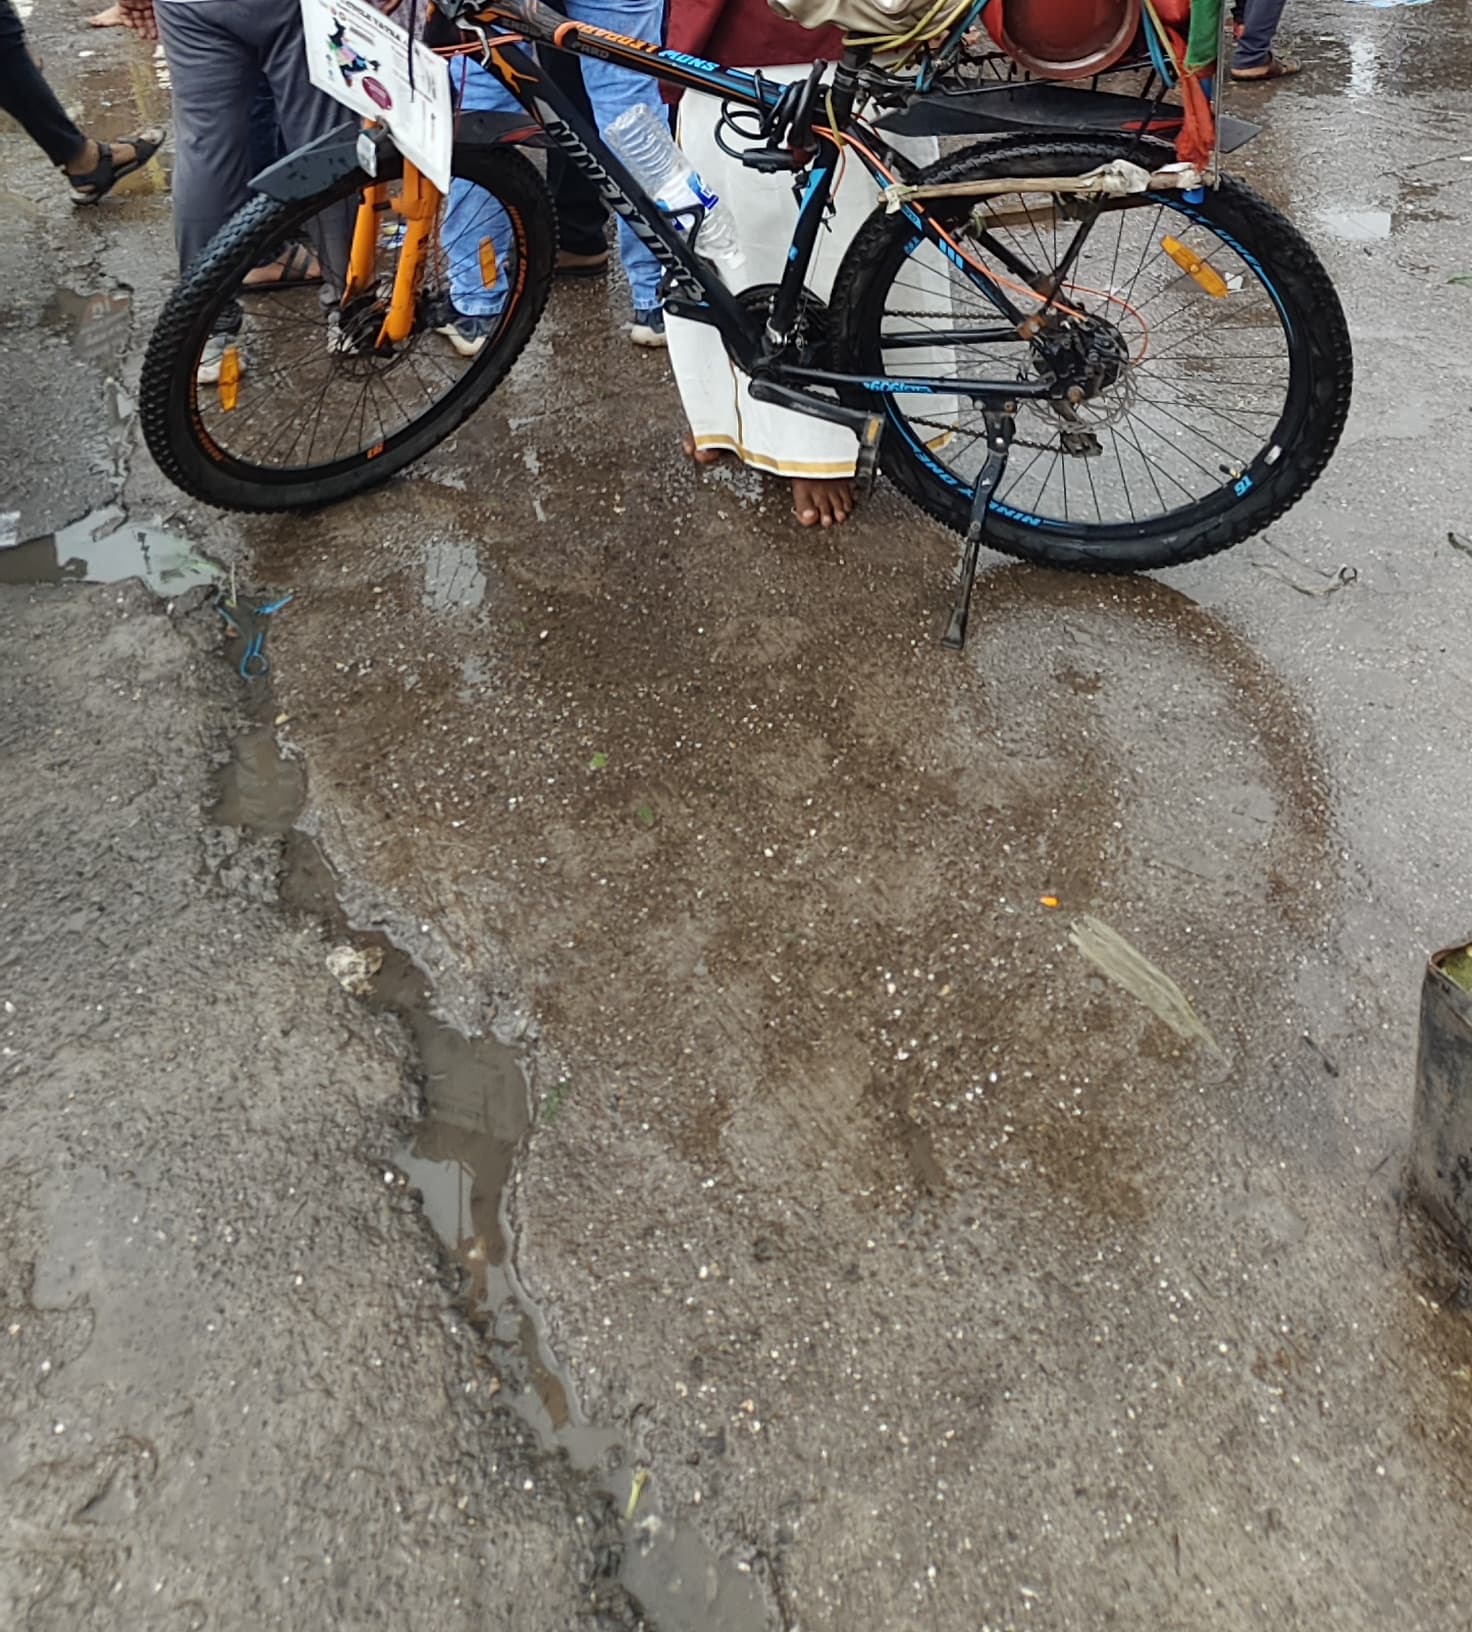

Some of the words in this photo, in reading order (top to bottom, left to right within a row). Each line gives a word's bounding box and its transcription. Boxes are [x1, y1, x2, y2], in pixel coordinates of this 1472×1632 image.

[658, 49, 720, 72] SNOW
[546, 119, 650, 226] NINETY
[640, 234, 706, 301] ONE
[957, 487, 1044, 527] NINEY
